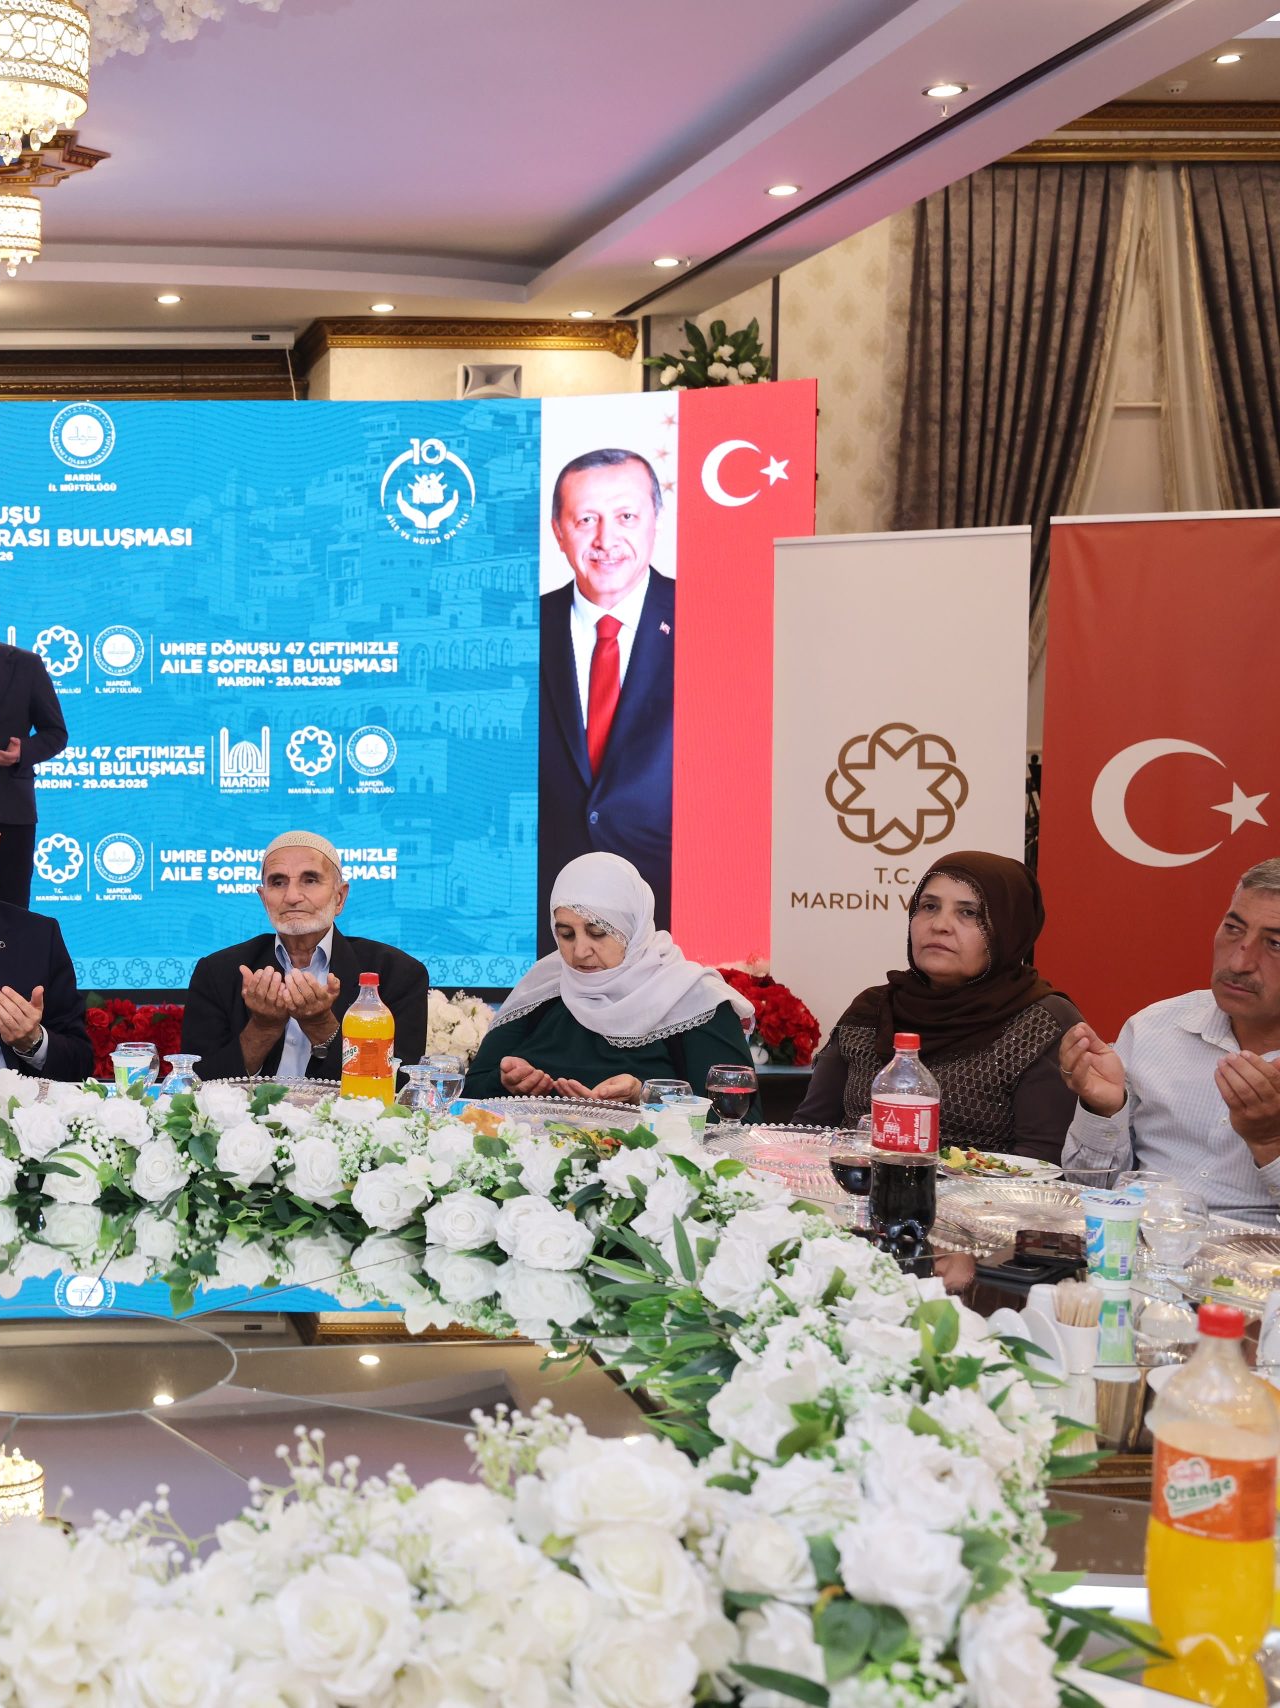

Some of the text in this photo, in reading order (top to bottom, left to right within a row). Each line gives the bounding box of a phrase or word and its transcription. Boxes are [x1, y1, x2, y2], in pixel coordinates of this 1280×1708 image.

[410, 438, 447, 465] 10
[57, 528, 192, 549] BULUŞMASI
[400, 530, 410, 540] VE
[444, 530, 456, 540] ON
[160, 643, 206, 655] UMRE
[285, 642, 304, 655] 47
[208, 659, 288, 673] SOFRASI
[293, 659, 398, 675] BULUŞMASI
[276, 676, 341, 686] 29.06.2026
[91, 747, 111, 759] 47
[100, 761, 205, 777] BULUŞMASI
[34, 780, 72, 788] ARDİN
[83, 779, 148, 788] 29.06.2026
[160, 850, 206, 862] UMRE
[874, 867, 916, 884] T.C.
[791, 890, 888, 910] MARDİN
[1166, 1478, 1232, 1500] Orange
